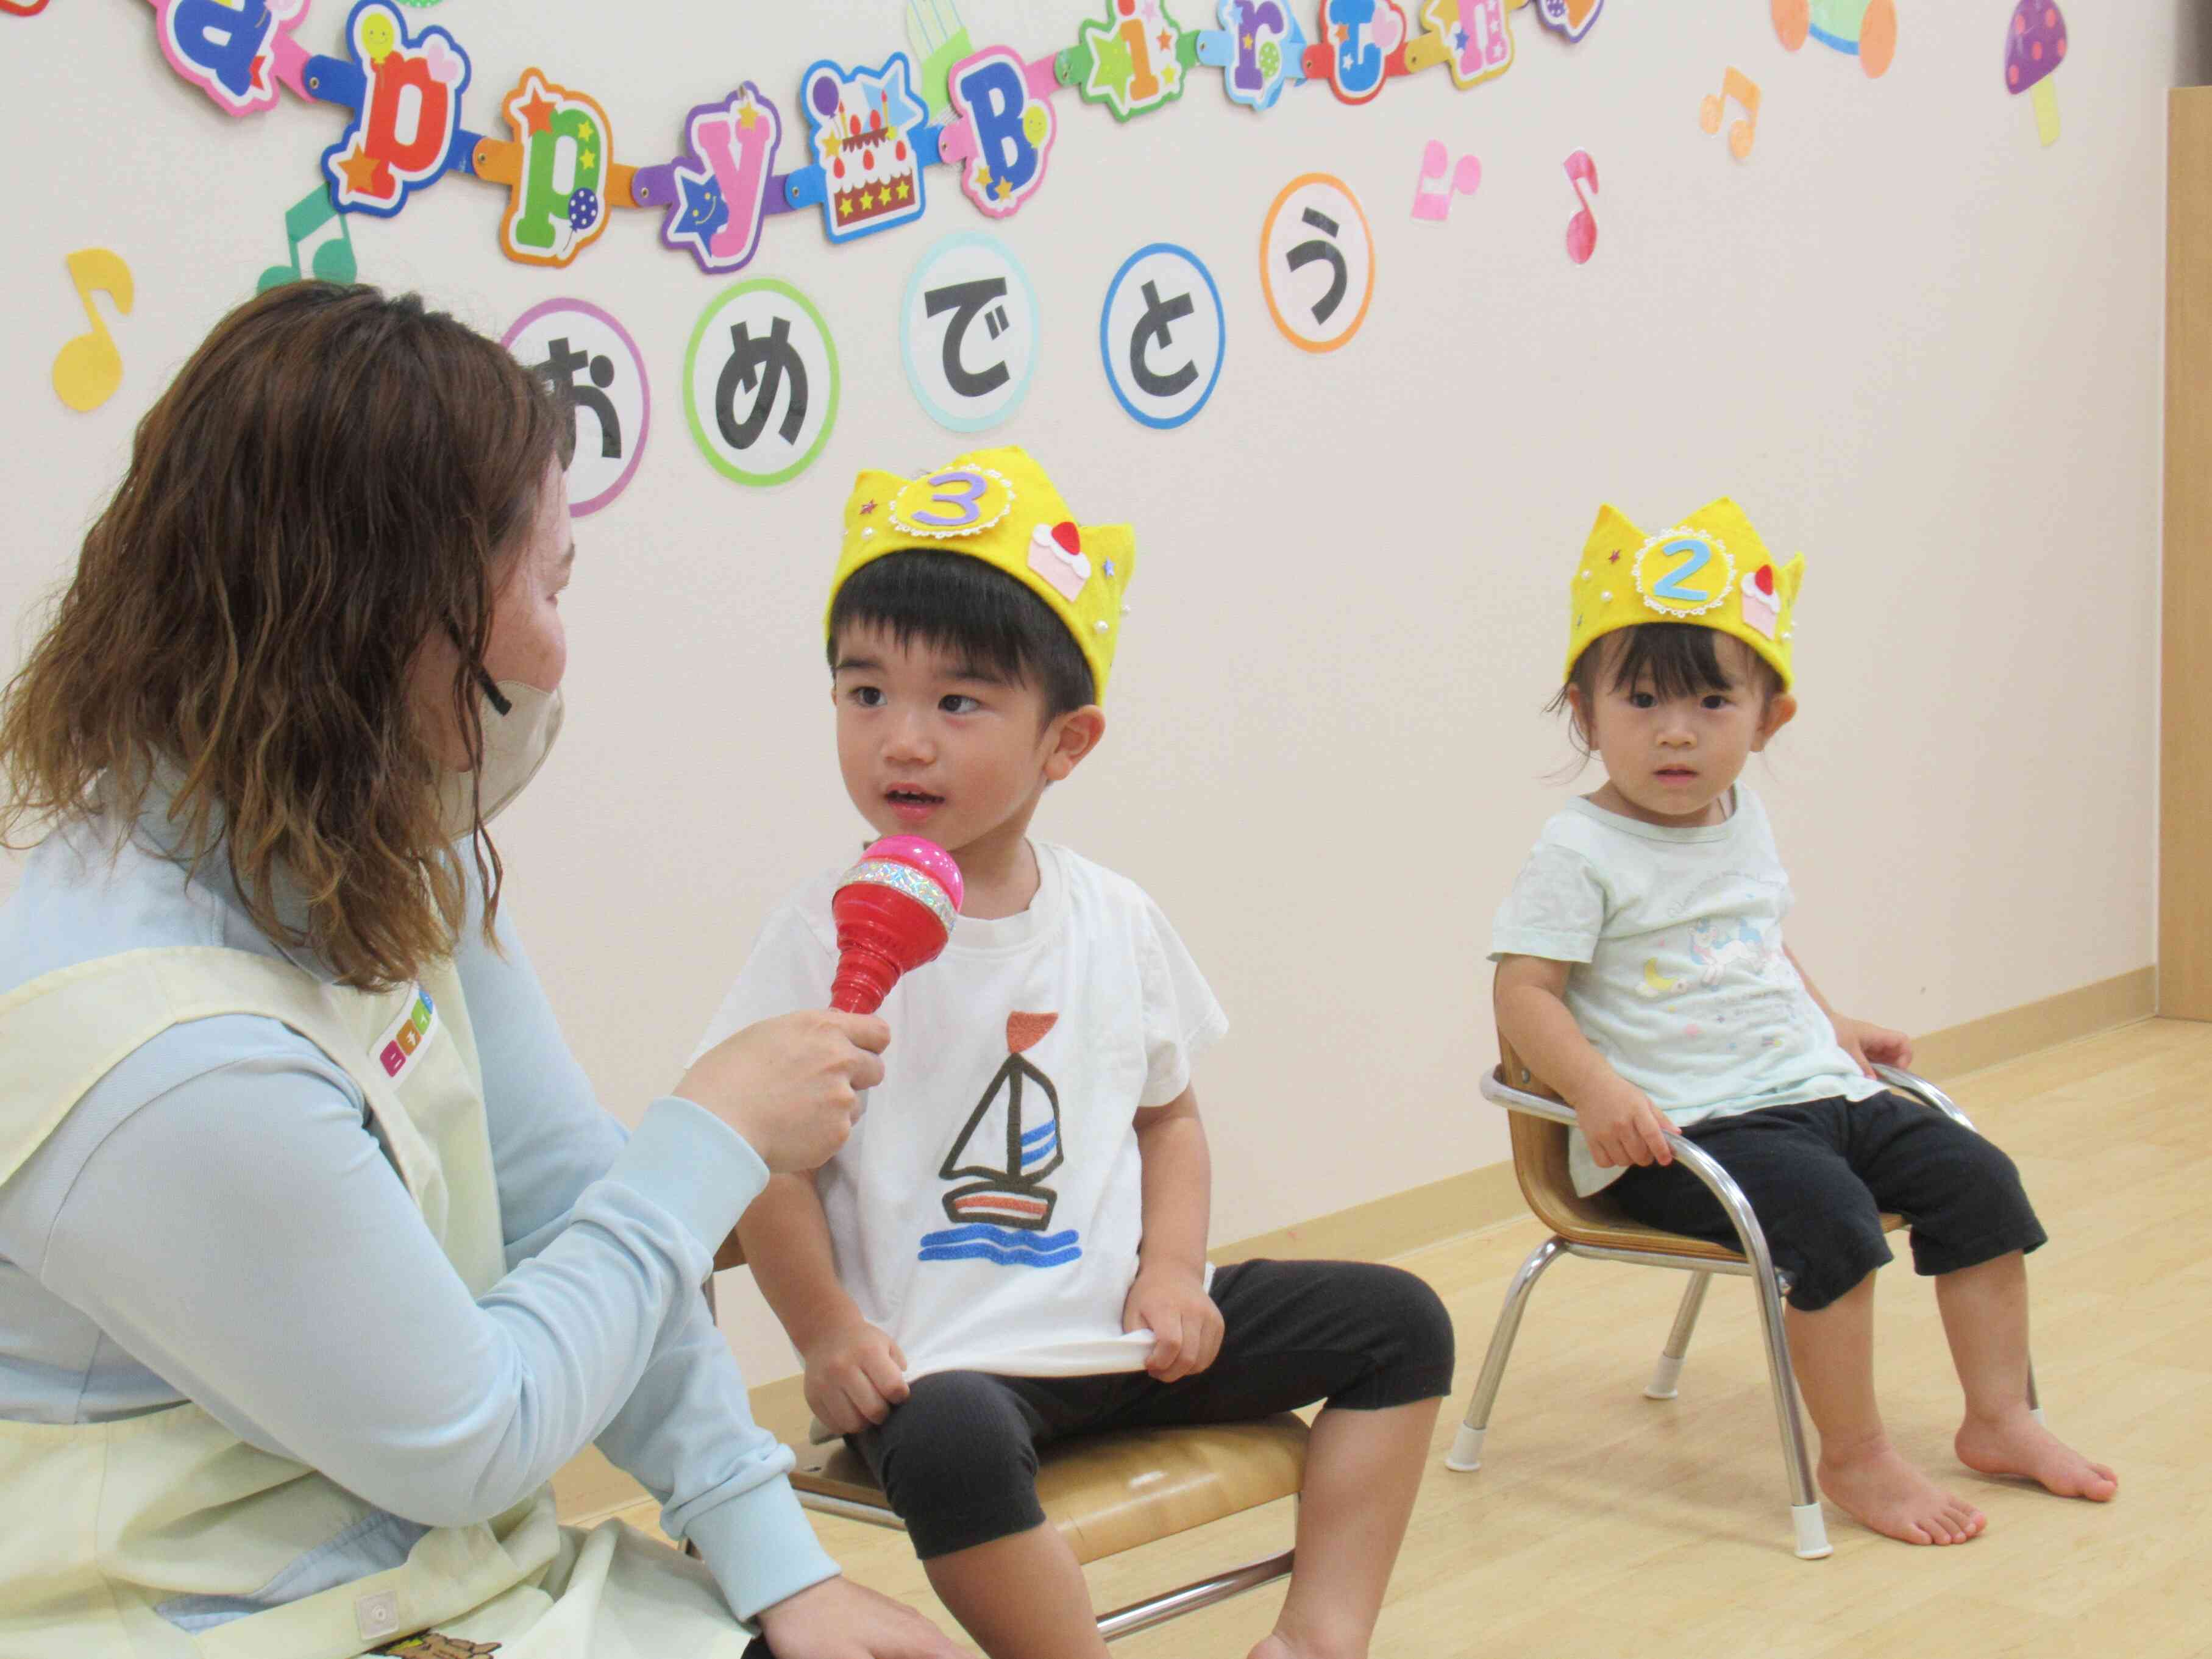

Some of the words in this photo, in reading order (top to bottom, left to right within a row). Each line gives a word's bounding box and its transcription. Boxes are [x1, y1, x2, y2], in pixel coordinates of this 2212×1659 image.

[174, 0, 770, 258] appy
[960, 0, 1595, 202] Birth
[524, 207, 1348, 473] おめでとう
[911, 471, 987, 527] 3
[1653, 539, 1711, 601] 2
